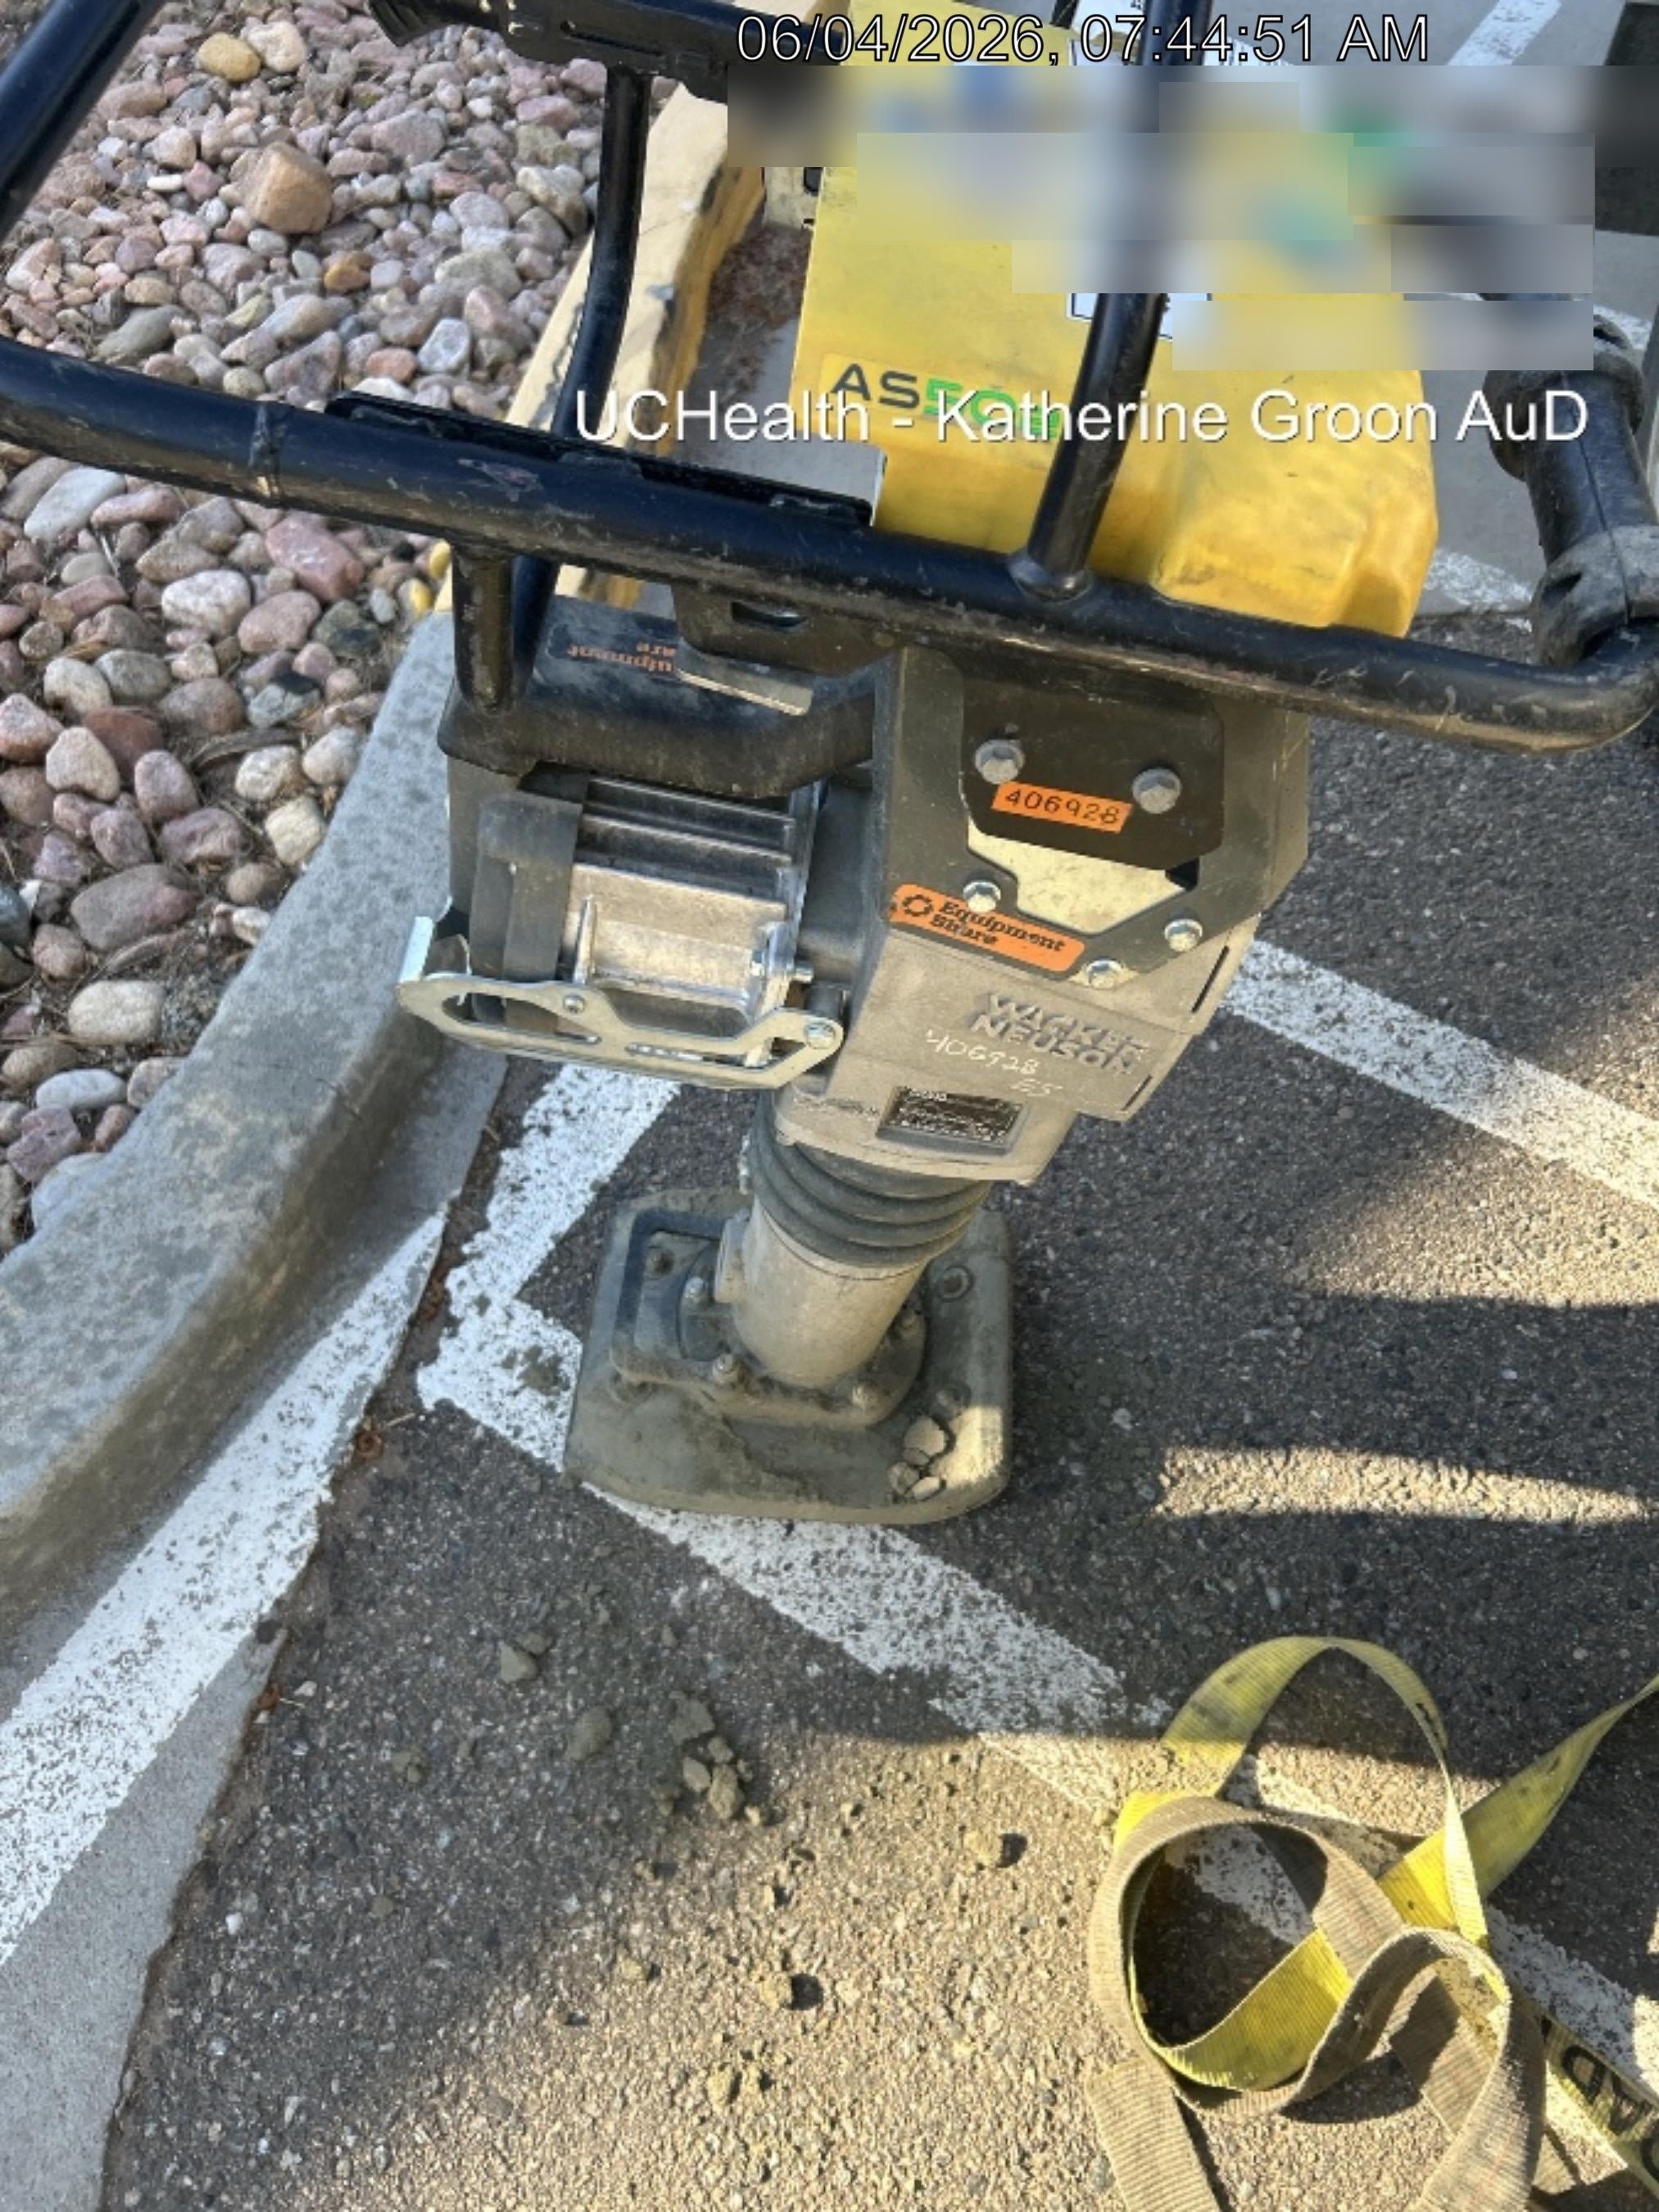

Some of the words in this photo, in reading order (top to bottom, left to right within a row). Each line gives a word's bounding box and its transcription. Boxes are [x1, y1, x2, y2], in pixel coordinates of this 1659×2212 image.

[1006, 788, 1120, 824] 406928
[931, 913, 999, 945] Share
[940, 901, 1065, 952] Equipment
[926, 1028, 1040, 1075] 406928
[969, 1013, 1141, 1076] NEUSON
